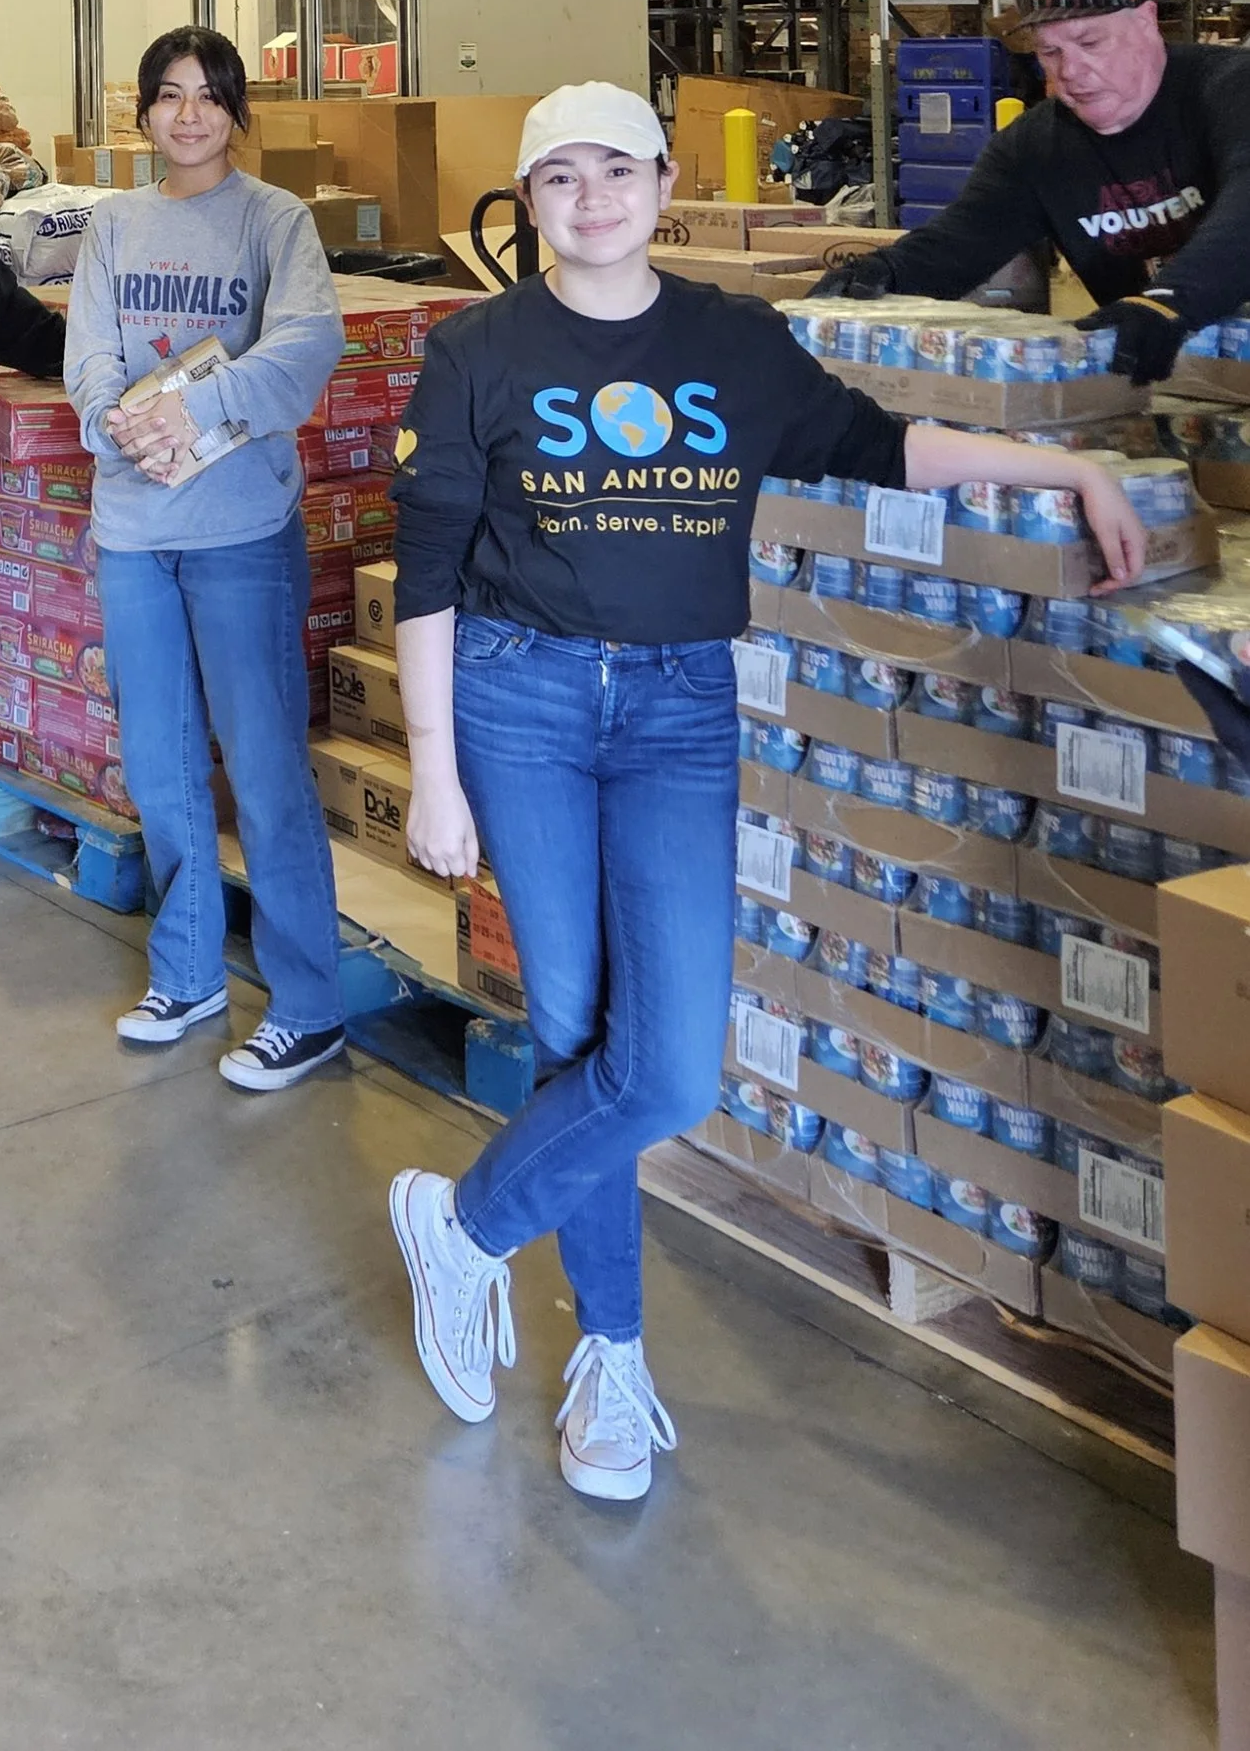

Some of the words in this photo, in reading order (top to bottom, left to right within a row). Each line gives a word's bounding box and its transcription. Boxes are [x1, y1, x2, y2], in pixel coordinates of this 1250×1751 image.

[149, 261, 190, 272] YWLA
[186, 316, 228, 329] DEPT
[532, 380, 727, 458] SOS
[40, 462, 90, 478] SRIRACHA
[521, 468, 586, 494] SAN
[602, 466, 741, 492] ANTONIO
[28, 517, 76, 539] SRIRACHA
[596, 513, 666, 533] Serve.
[26, 633, 75, 658] SRIRACHA
[331, 664, 366, 698] Dole
[363, 786, 400, 825] Dole
[946, 1098, 979, 1119] PINK
